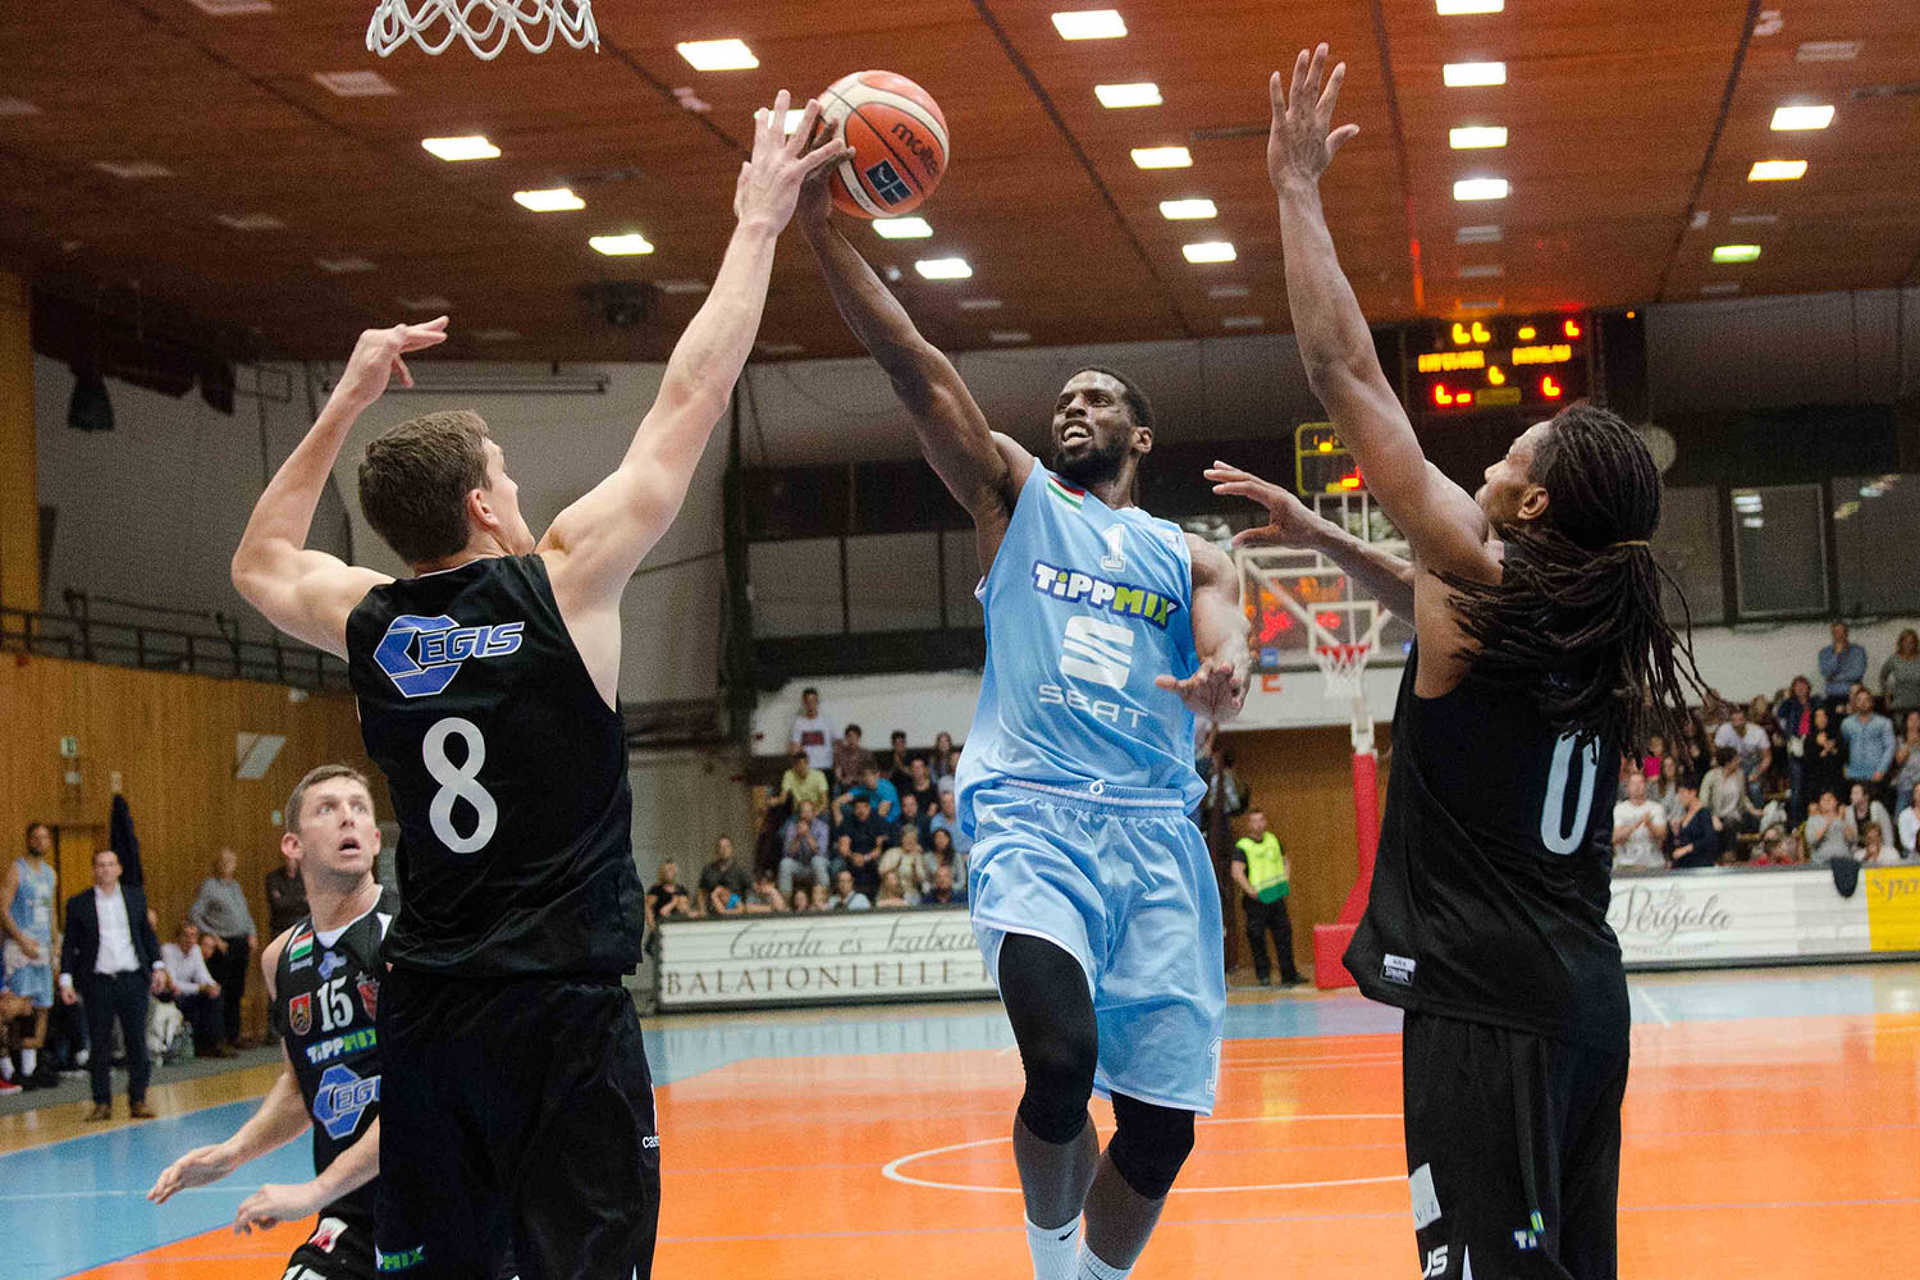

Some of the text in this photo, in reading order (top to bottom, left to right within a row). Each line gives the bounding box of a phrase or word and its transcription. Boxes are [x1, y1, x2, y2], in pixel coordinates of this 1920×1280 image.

[1101, 523, 1126, 571] 1
[417, 621, 526, 666] EGIS
[1038, 684, 1149, 728] SEAT
[422, 716, 498, 854] 8
[1541, 729, 1600, 855] 0
[317, 976, 354, 1032] 15
